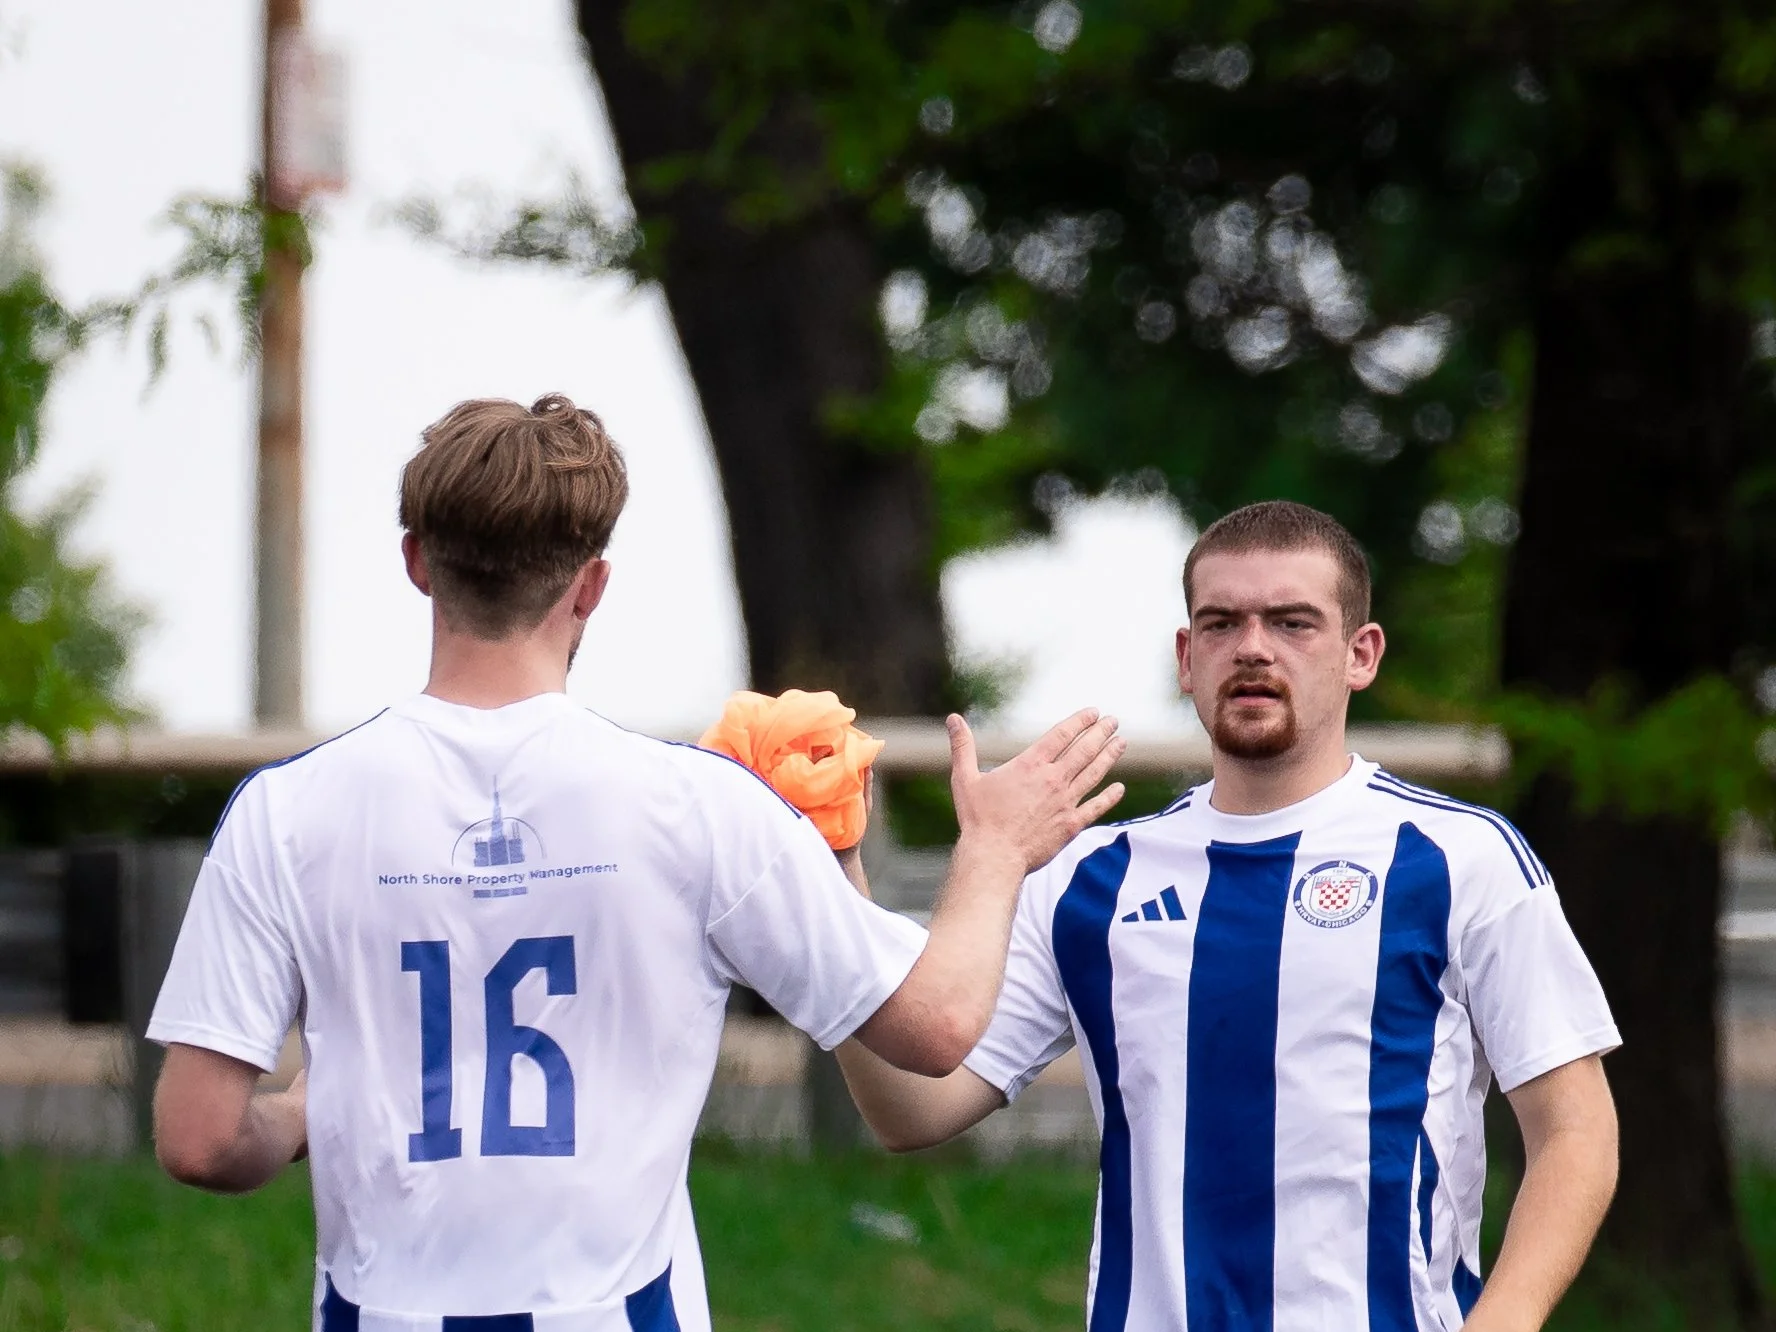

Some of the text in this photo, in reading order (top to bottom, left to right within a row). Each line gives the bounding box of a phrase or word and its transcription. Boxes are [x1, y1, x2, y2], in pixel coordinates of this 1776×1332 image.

[378, 872, 418, 885] North
[422, 872, 463, 885] Shore
[467, 872, 526, 886] Property
[400, 935, 577, 1163] 16
